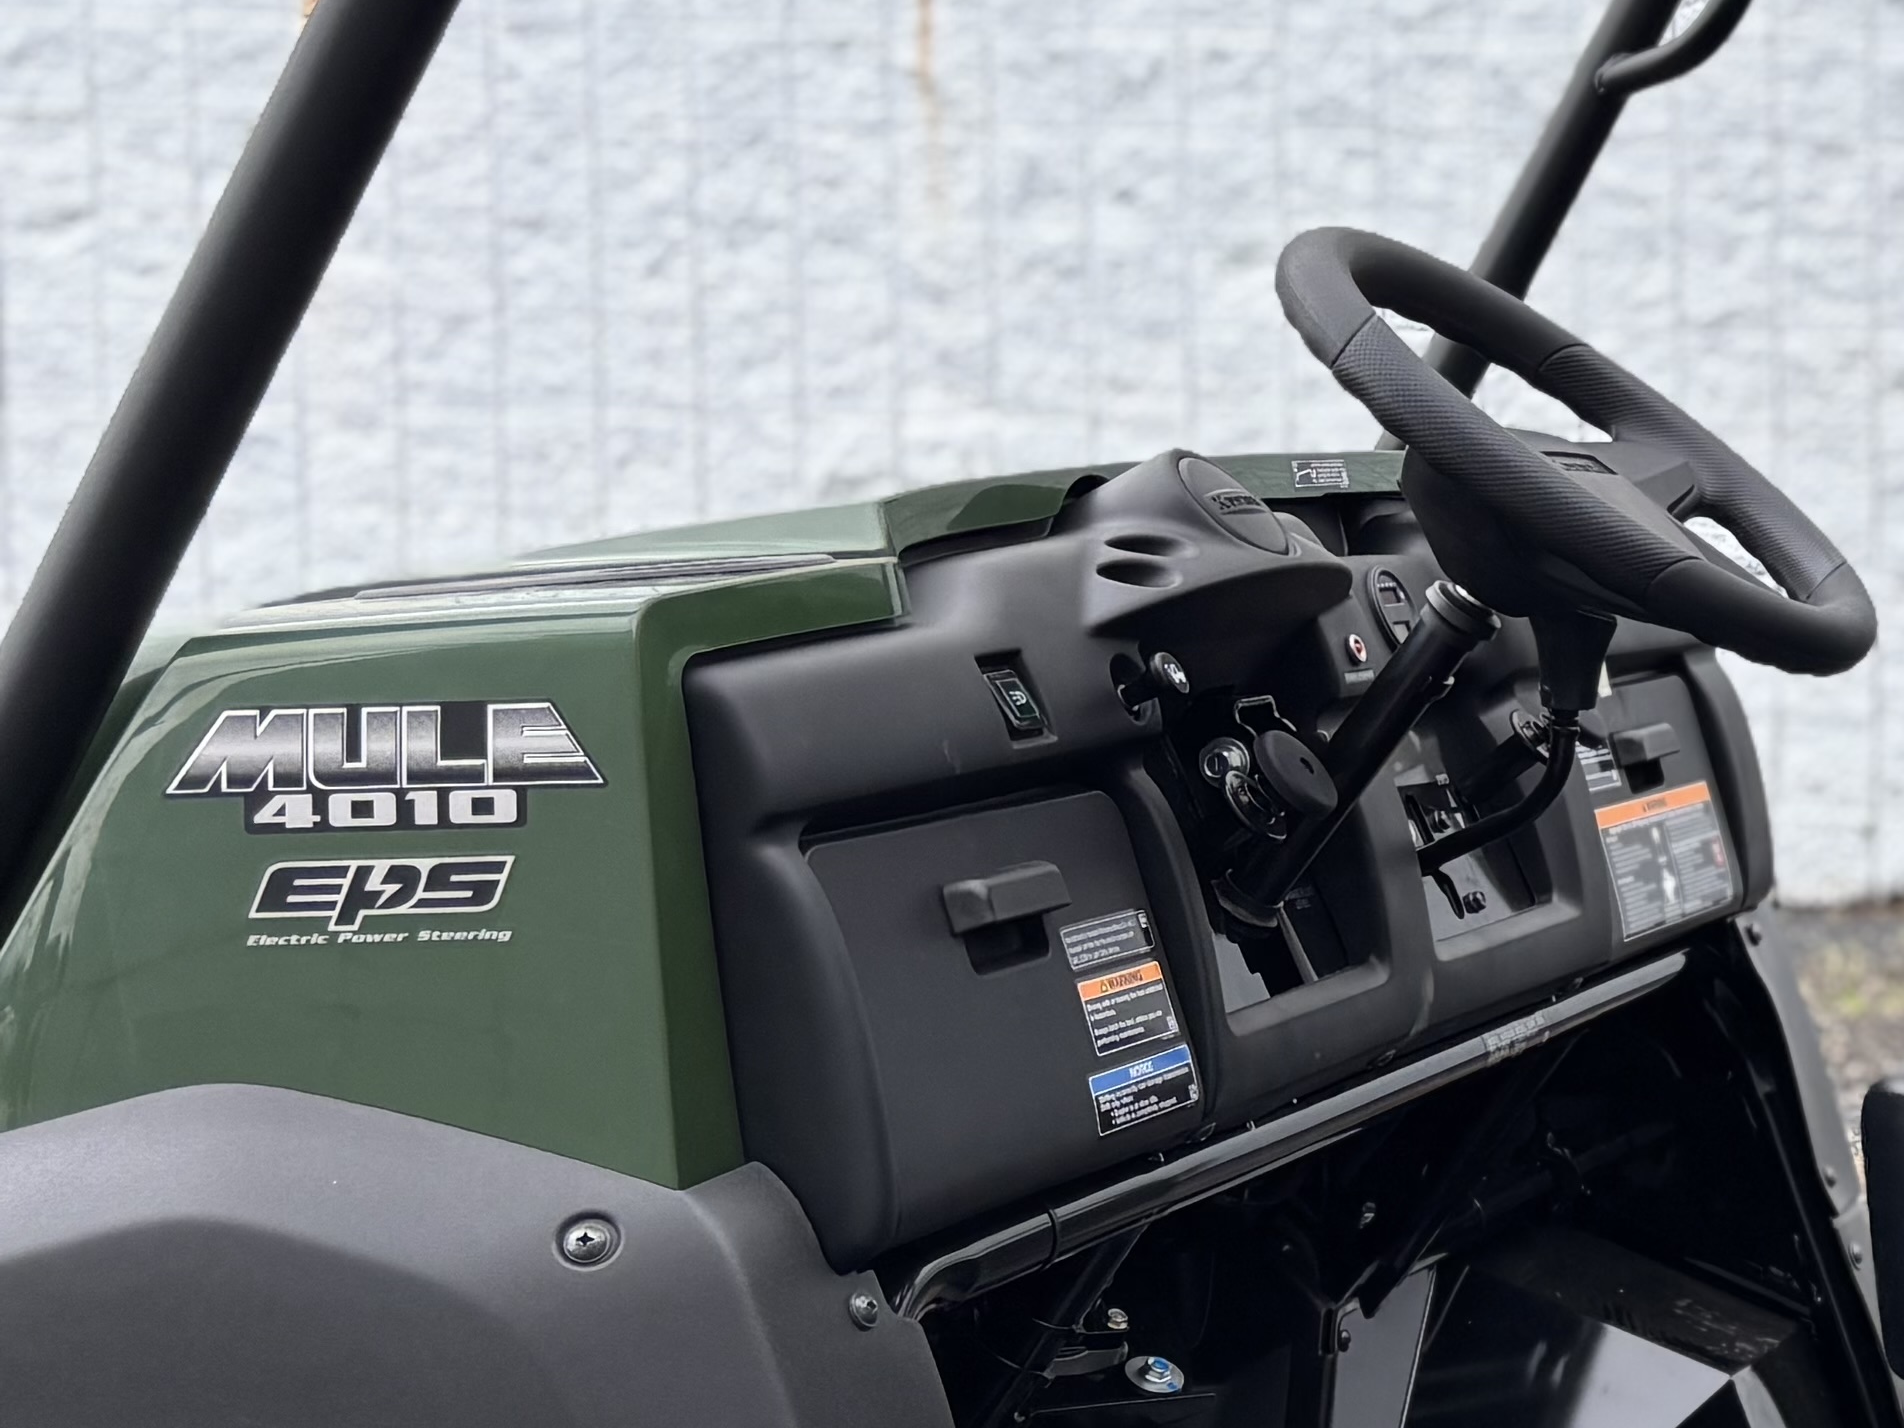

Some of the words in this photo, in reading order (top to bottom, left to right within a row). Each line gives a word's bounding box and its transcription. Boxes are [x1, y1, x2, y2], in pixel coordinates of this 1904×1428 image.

[165, 702, 605, 794] MULE
[254, 789, 518, 828] 4010
[248, 855, 516, 931] EPS
[247, 933, 329, 946] Electric
[338, 930, 409, 944] Power
[418, 928, 513, 943] Steering
